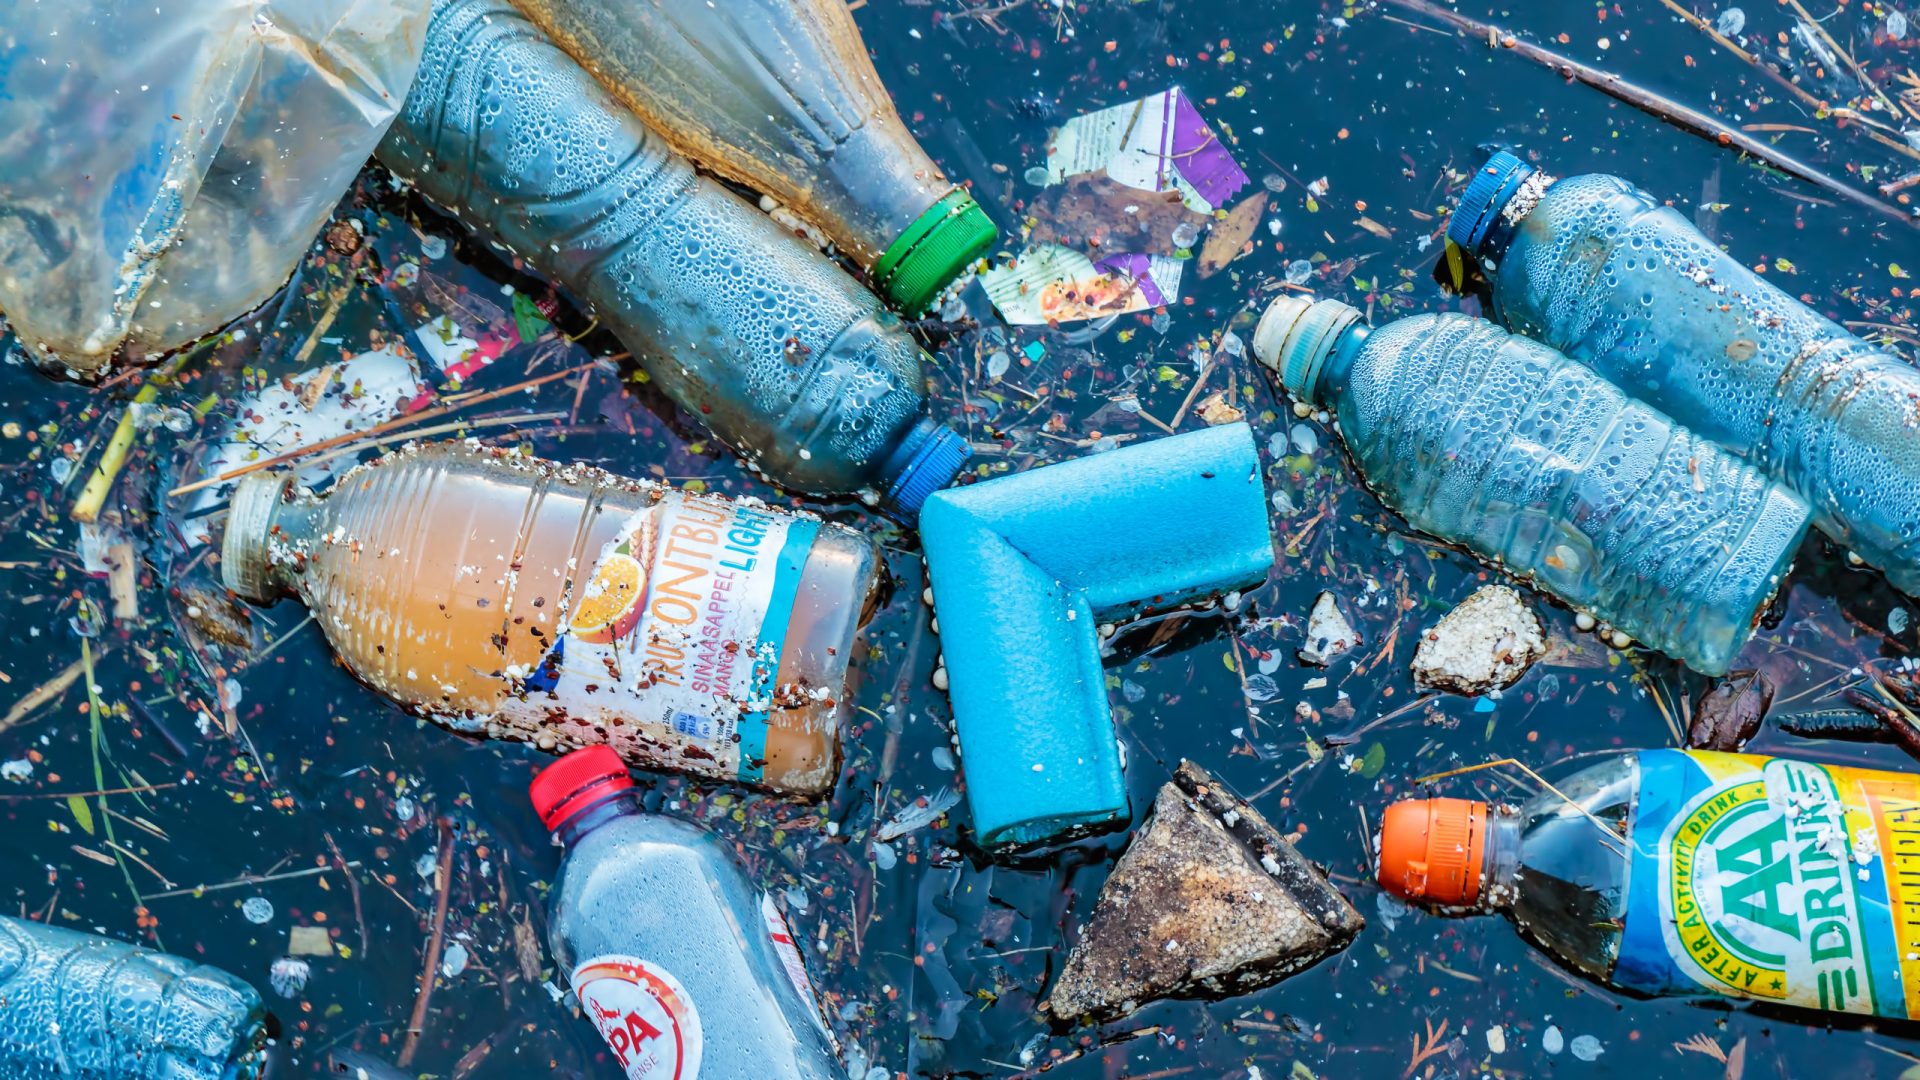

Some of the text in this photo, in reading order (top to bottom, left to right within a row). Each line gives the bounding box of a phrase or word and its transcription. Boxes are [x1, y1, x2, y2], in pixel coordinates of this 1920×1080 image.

[719, 507, 772, 571] LIGHT
[691, 571, 736, 694] SINAASAPPEL
[1675, 790, 1759, 987] AFTER ACTIVITY DRINK
[1715, 815, 1802, 942] AA
[1788, 798, 1853, 964] DRINK
[607, 1011, 662, 1070] PA
